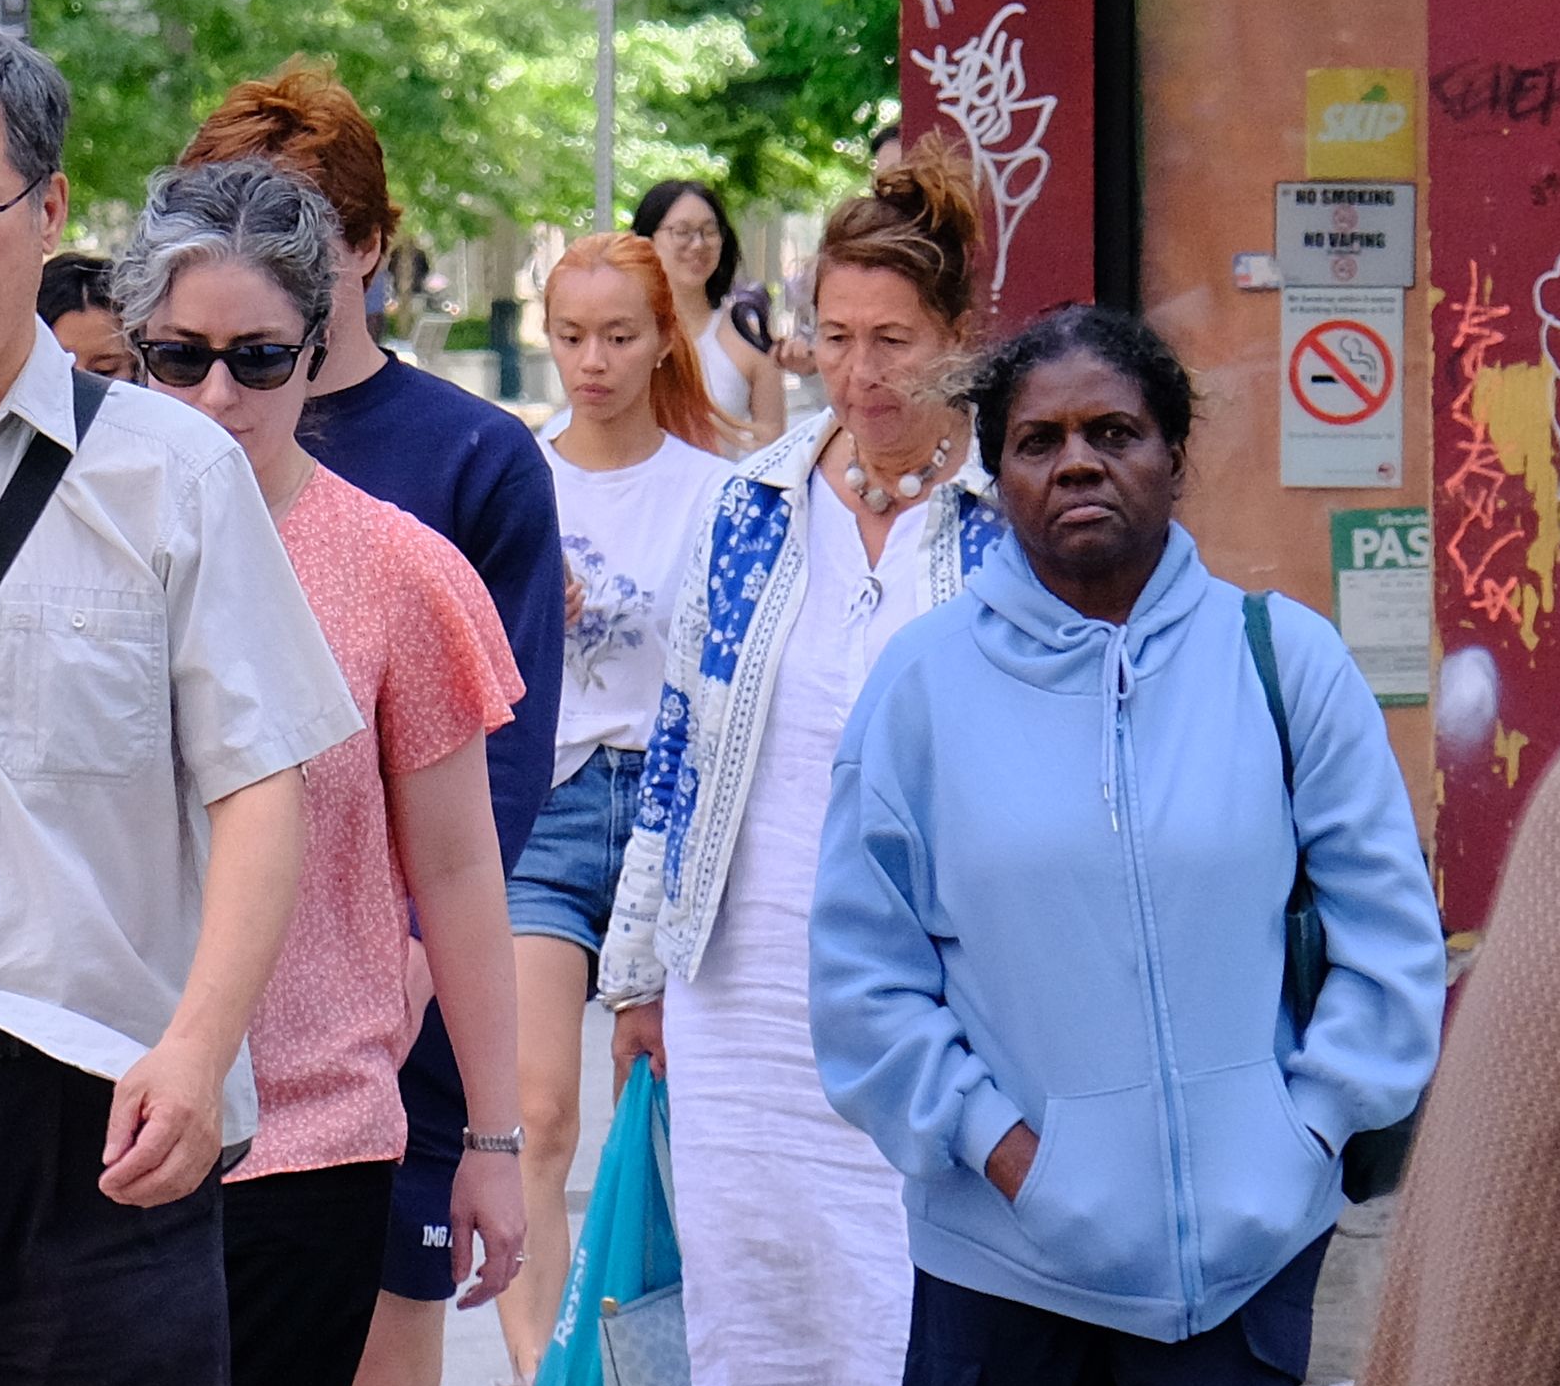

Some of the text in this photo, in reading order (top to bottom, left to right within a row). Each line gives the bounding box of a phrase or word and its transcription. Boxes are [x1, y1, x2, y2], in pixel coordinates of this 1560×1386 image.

[1317, 101, 1408, 142] SKIP
[1296, 189, 1395, 206] NO SMOKING
[1304, 232, 1386, 248] NO VAPING
[553, 1248, 587, 1348] Rexall
